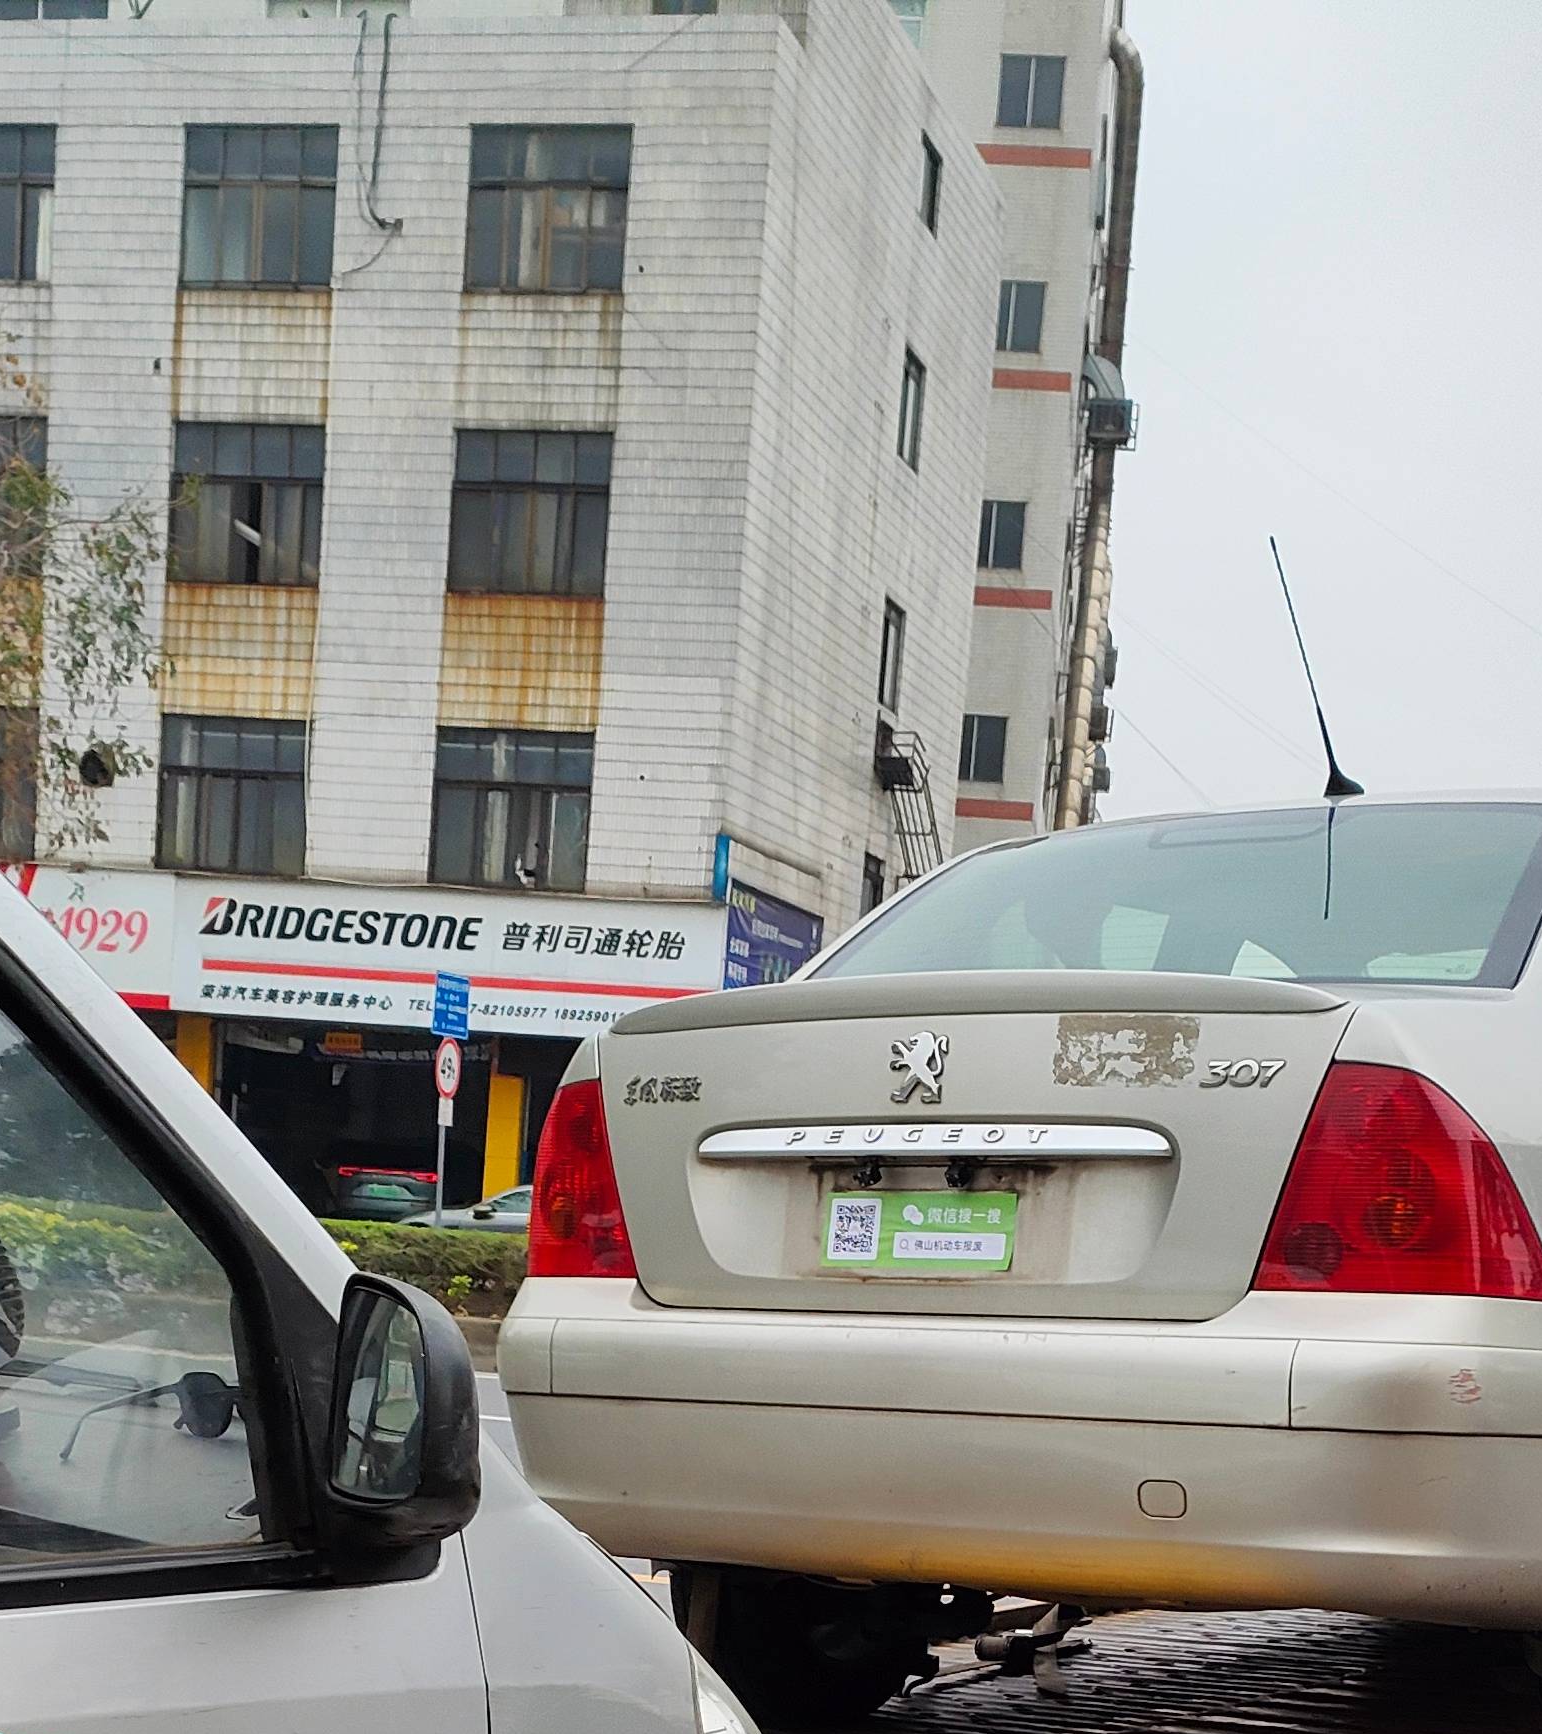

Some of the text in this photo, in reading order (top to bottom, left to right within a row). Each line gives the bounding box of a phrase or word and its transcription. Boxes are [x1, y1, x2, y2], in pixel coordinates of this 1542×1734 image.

[43, 906, 149, 954] 1929
[199, 897, 483, 951] BRIDGESTONE
[502, 921, 686, 961] 普利司通轮胎
[469, 1003, 547, 1019] 7-82105977
[554, 1009, 624, 1023] 18925901
[1199, 1058, 1287, 1088] 307
[785, 1127, 1049, 1146] PEUGEOT
[927, 1207, 1002, 1225] 微信搜一搜
[914, 1239, 983, 1252] 佛山机动车报废
